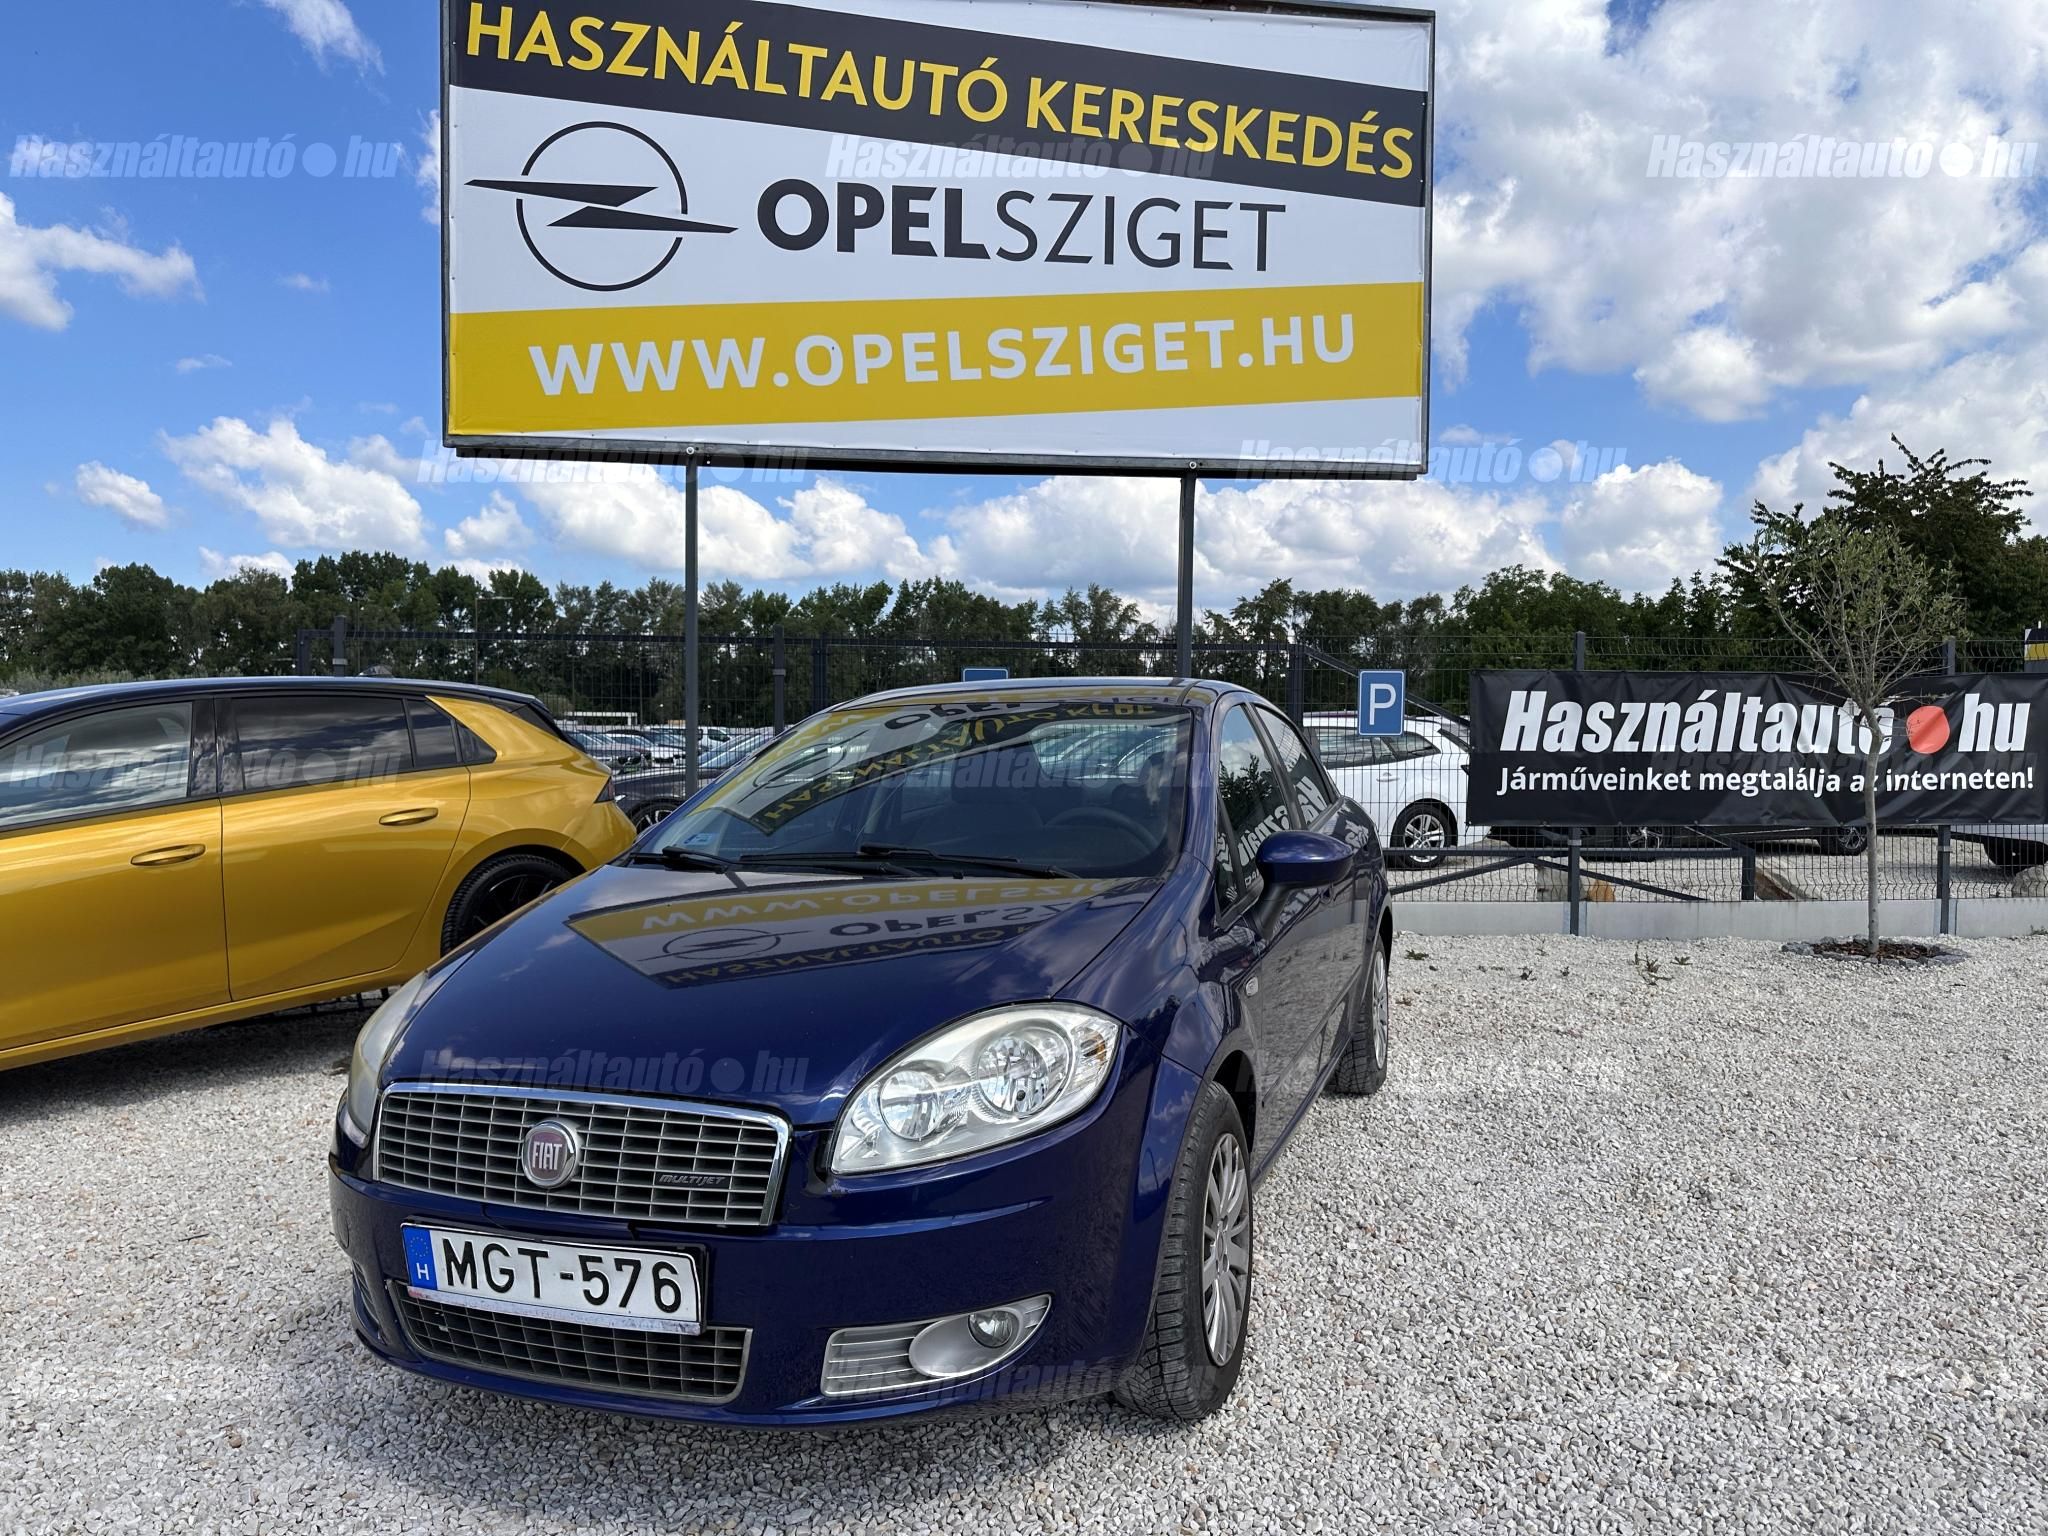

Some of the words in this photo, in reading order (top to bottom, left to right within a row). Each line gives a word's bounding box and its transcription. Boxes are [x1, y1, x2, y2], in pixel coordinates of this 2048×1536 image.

[466, 2, 1008, 123] HASZNÁLTAUTÓ
[1025, 76, 1414, 180] KERESKEDÉS
[757, 178, 1287, 272] OPELSZIGET
[528, 313, 1356, 396] WWW.OPELSZIGET.HU
[1368, 683, 1397, 726] P
[1499, 688, 1894, 755] Használtautó
[1958, 693, 2031, 753] hu
[1497, 765, 1691, 796] Járműveinket
[1699, 767, 1840, 798] megtalálja
[1885, 766, 2034, 792] interneten!
[532, 1141, 563, 1171] FIAT
[658, 1173, 725, 1187] MULTIJET
[416, 1262, 430, 1281] H
[442, 1237, 682, 1314] MGT-576
